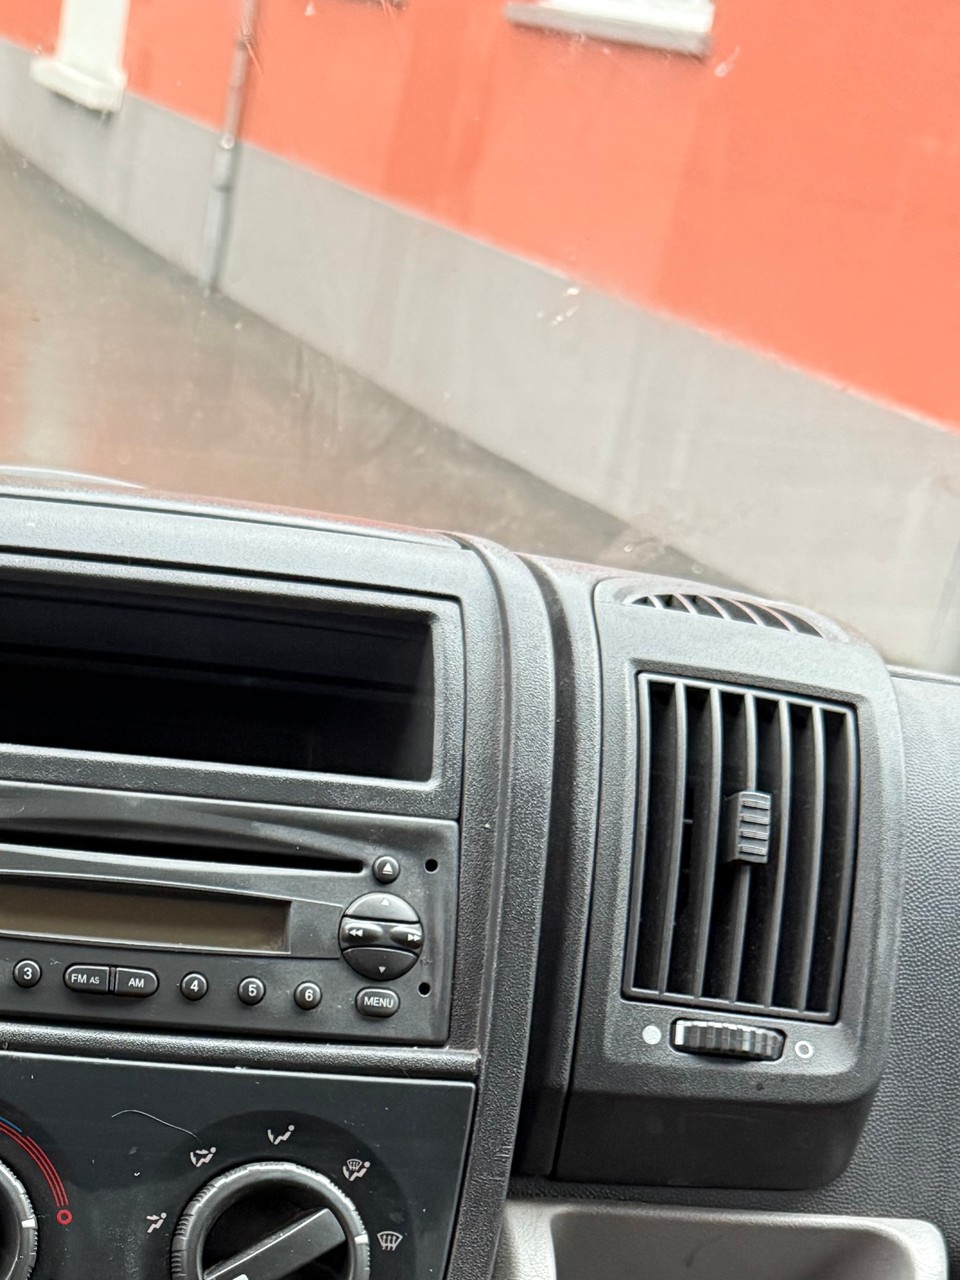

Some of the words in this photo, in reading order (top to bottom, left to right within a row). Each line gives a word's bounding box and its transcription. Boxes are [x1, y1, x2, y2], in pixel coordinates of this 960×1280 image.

[23, 967, 32, 980] 3
[71, 974, 87, 984] FM
[90, 976, 100, 984] AS
[128, 977, 145, 988] AM
[190, 980, 199, 992] 4
[248, 984, 257, 997] 5
[305, 990, 313, 1001] 6
[364, 997, 394, 1009] MENU
